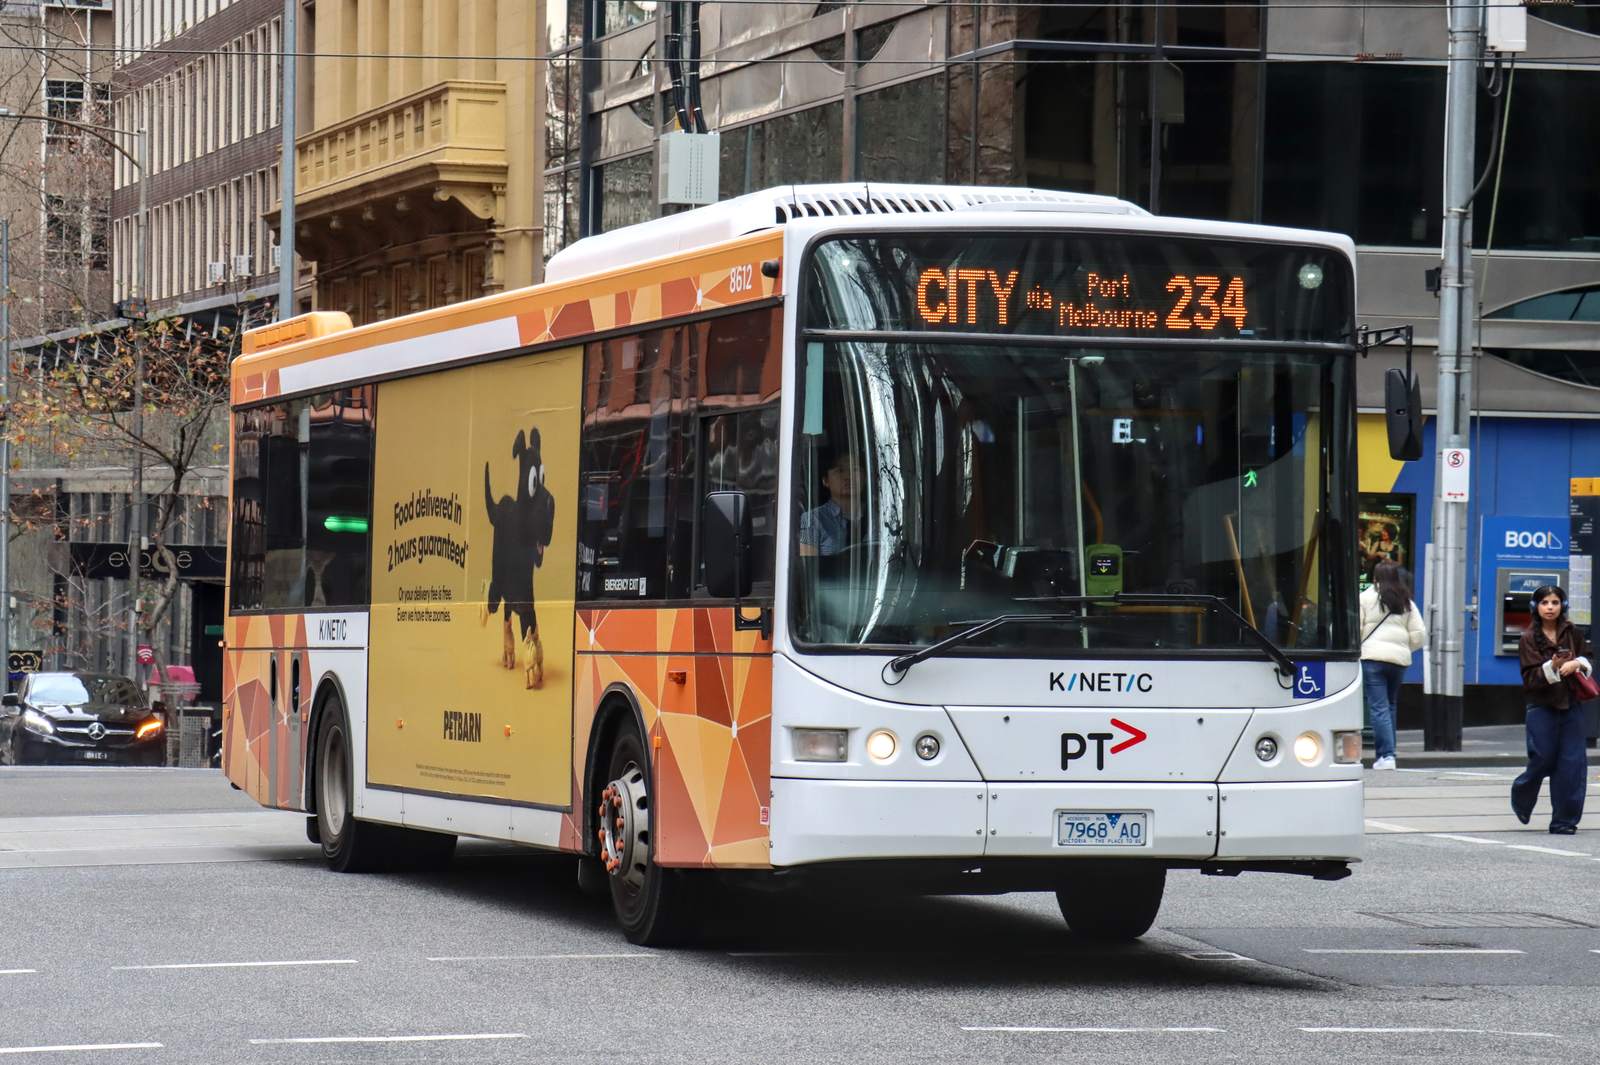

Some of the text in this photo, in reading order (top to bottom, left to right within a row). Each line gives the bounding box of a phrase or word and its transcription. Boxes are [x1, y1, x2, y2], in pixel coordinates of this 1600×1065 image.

[729, 263, 752, 294] 8612
[1088, 273, 1130, 298] Port
[917, 268, 1052, 325] CITY via
[1165, 275, 1248, 330] 234
[1060, 303, 1158, 328] Melbourne
[394, 487, 462, 530] Food delivered in
[1505, 530, 1547, 548] BOQ
[388, 544, 393, 573] 2
[394, 539, 417, 567] hours
[629, 578, 639, 591] EXIT
[443, 710, 481, 743] PETBARN
[1064, 822, 1108, 839] 7968
